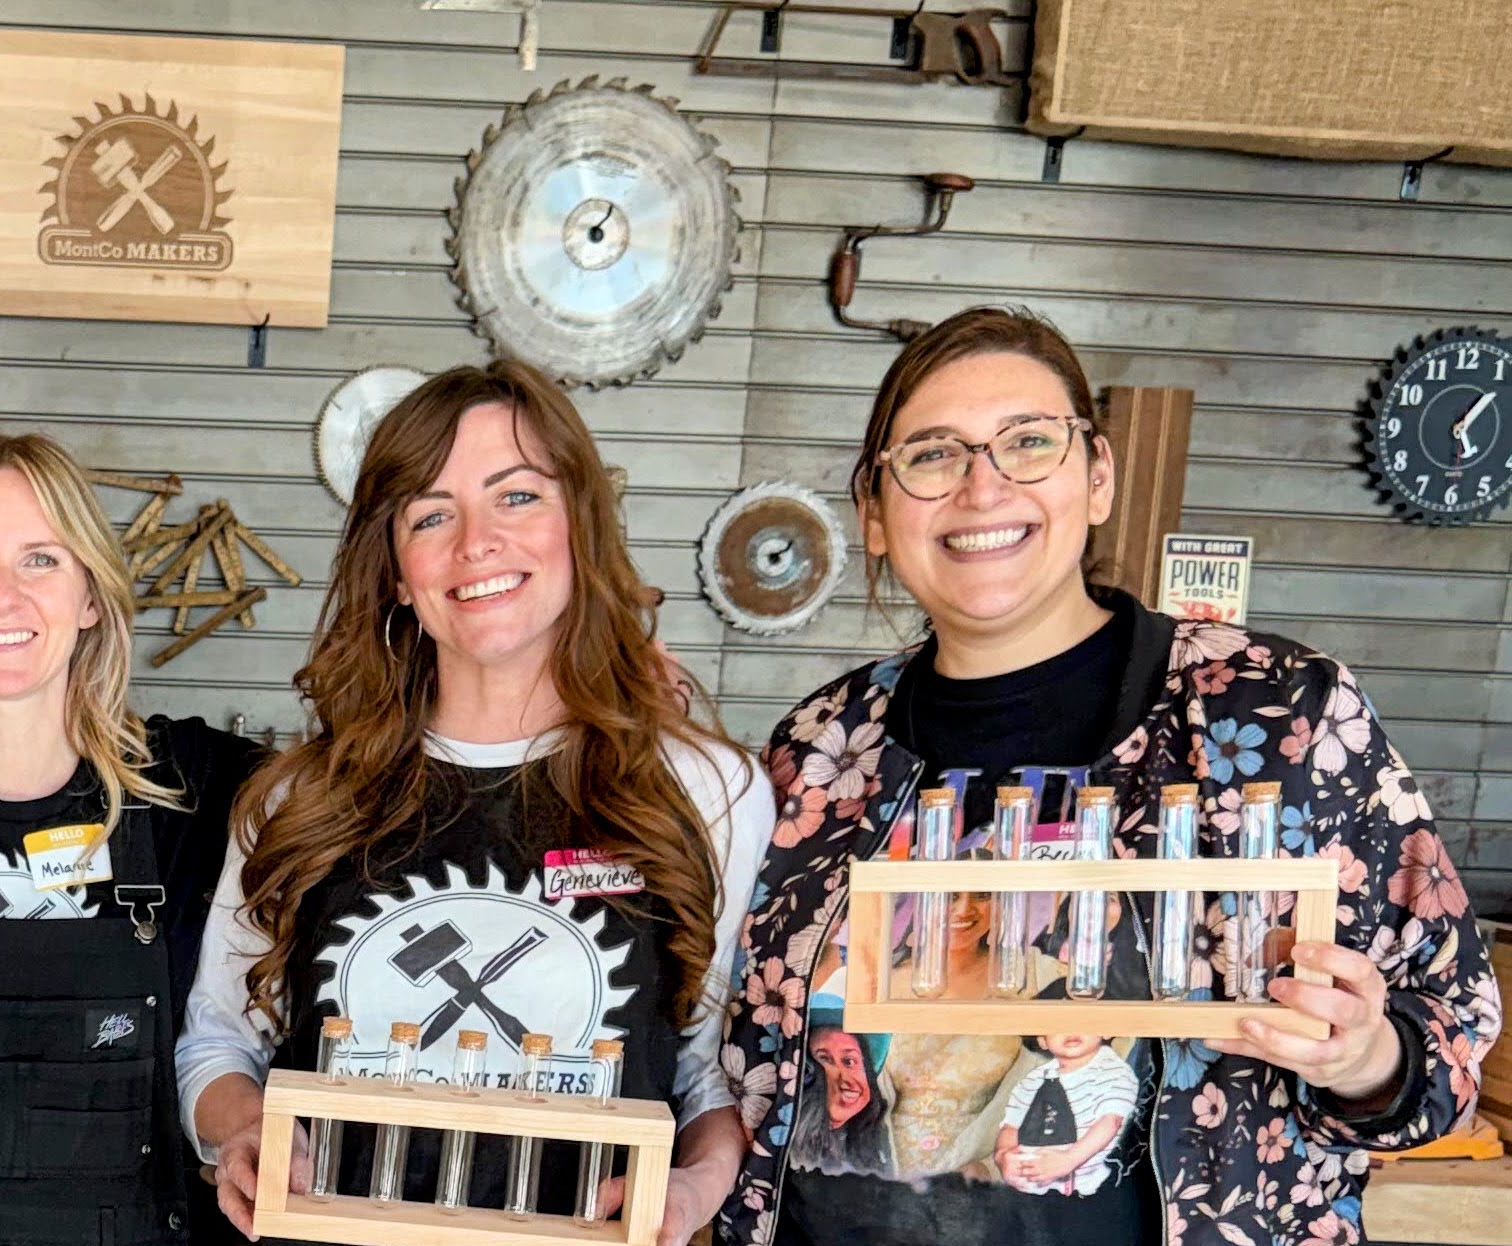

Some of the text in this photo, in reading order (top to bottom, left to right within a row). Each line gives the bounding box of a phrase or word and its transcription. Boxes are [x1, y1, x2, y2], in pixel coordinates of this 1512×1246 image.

[55, 240, 219, 261] MontCo MAKERS
[1425, 358, 1448, 381] 11
[1455, 348, 1480, 370] 12
[1493, 359, 1505, 381] 1
[1399, 384, 1423, 406] 10
[1387, 417, 1402, 439] 9
[1393, 450, 1408, 472] 8
[1415, 474, 1430, 497] 7
[1444, 484, 1458, 505] 6
[1476, 475, 1492, 497] 5
[1171, 541, 1243, 554] WITH GREAT
[1170, 559, 1240, 592] POWER
[1184, 588, 1224, 600] TOOLS
[49, 828, 85, 842] HELLO
[550, 869, 642, 897] Genevieve
